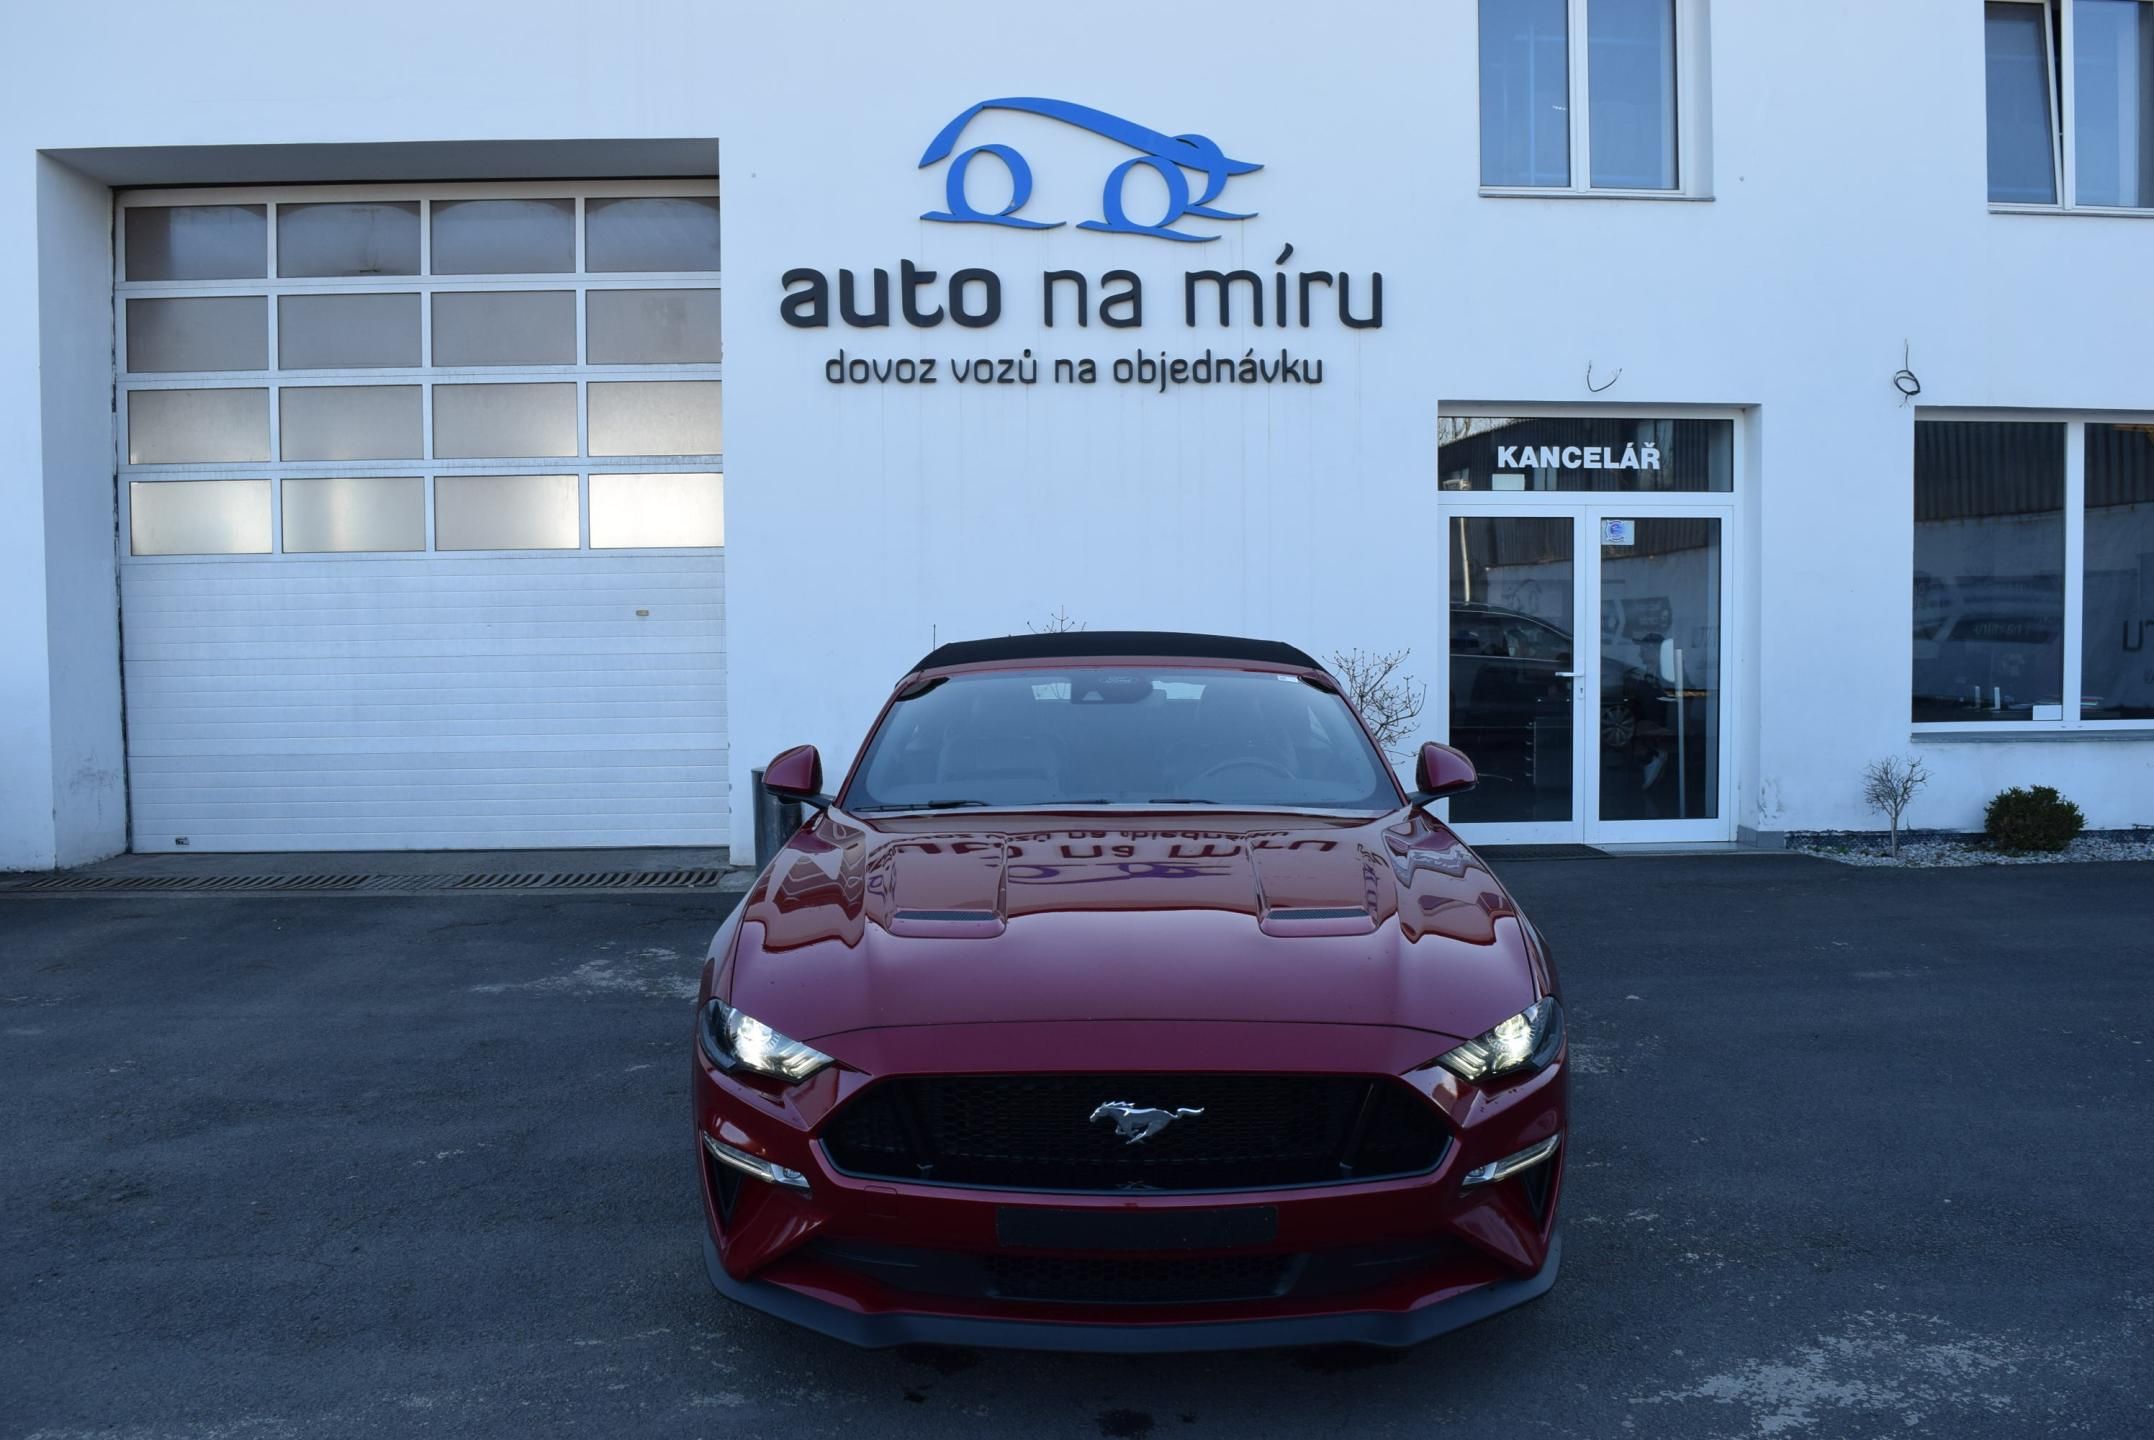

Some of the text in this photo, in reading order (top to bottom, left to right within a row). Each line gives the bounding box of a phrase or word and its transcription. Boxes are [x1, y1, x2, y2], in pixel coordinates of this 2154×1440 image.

[779, 242, 1383, 330] auto na míru
[825, 347, 1323, 394] dovoz vozů na objednávku
[1498, 441, 1660, 470] KANCELÁŘ
